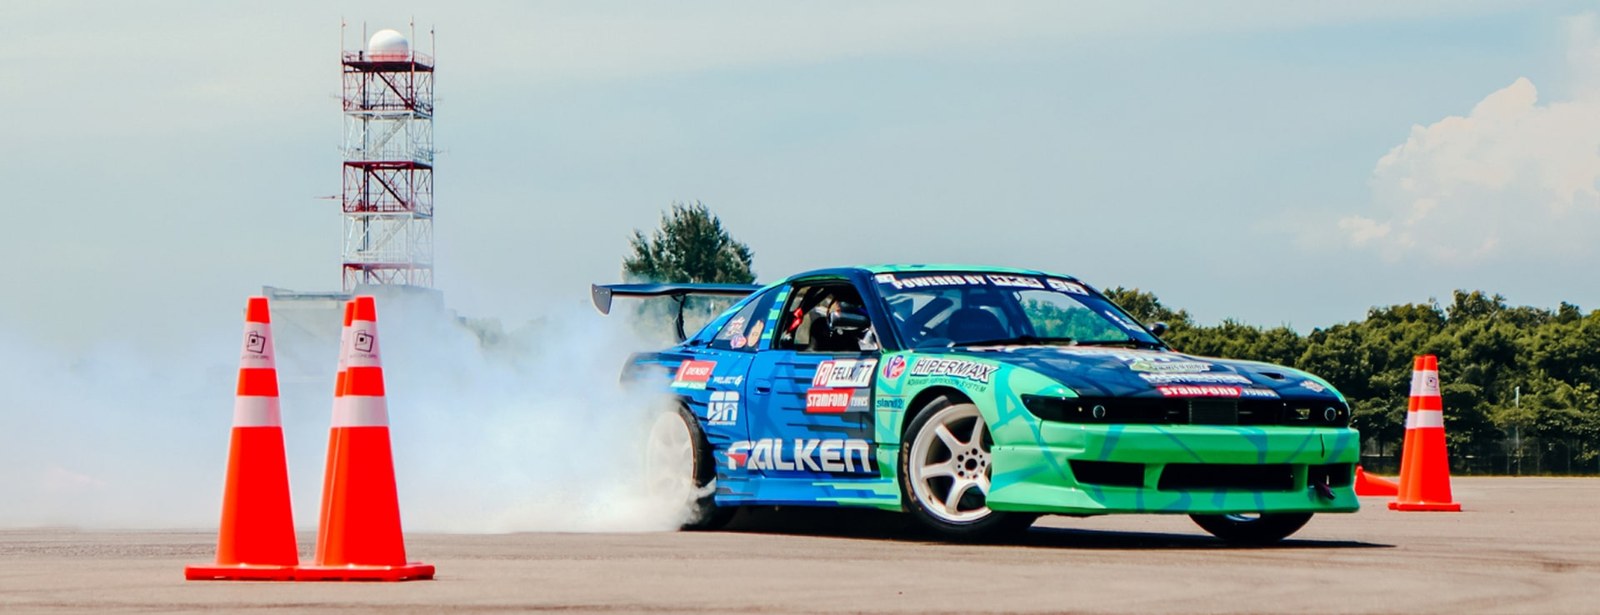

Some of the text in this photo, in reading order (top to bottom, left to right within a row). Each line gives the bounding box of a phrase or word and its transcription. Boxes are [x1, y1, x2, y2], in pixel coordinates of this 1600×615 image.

[891, 276, 966, 289] POWERED
[964, 275, 987, 285] BY
[685, 367, 710, 376] DENSO
[831, 366, 858, 381] FELIX
[857, 364, 873, 383] 77
[911, 359, 998, 383] HIPERMAX
[726, 438, 872, 473] FALKEN
